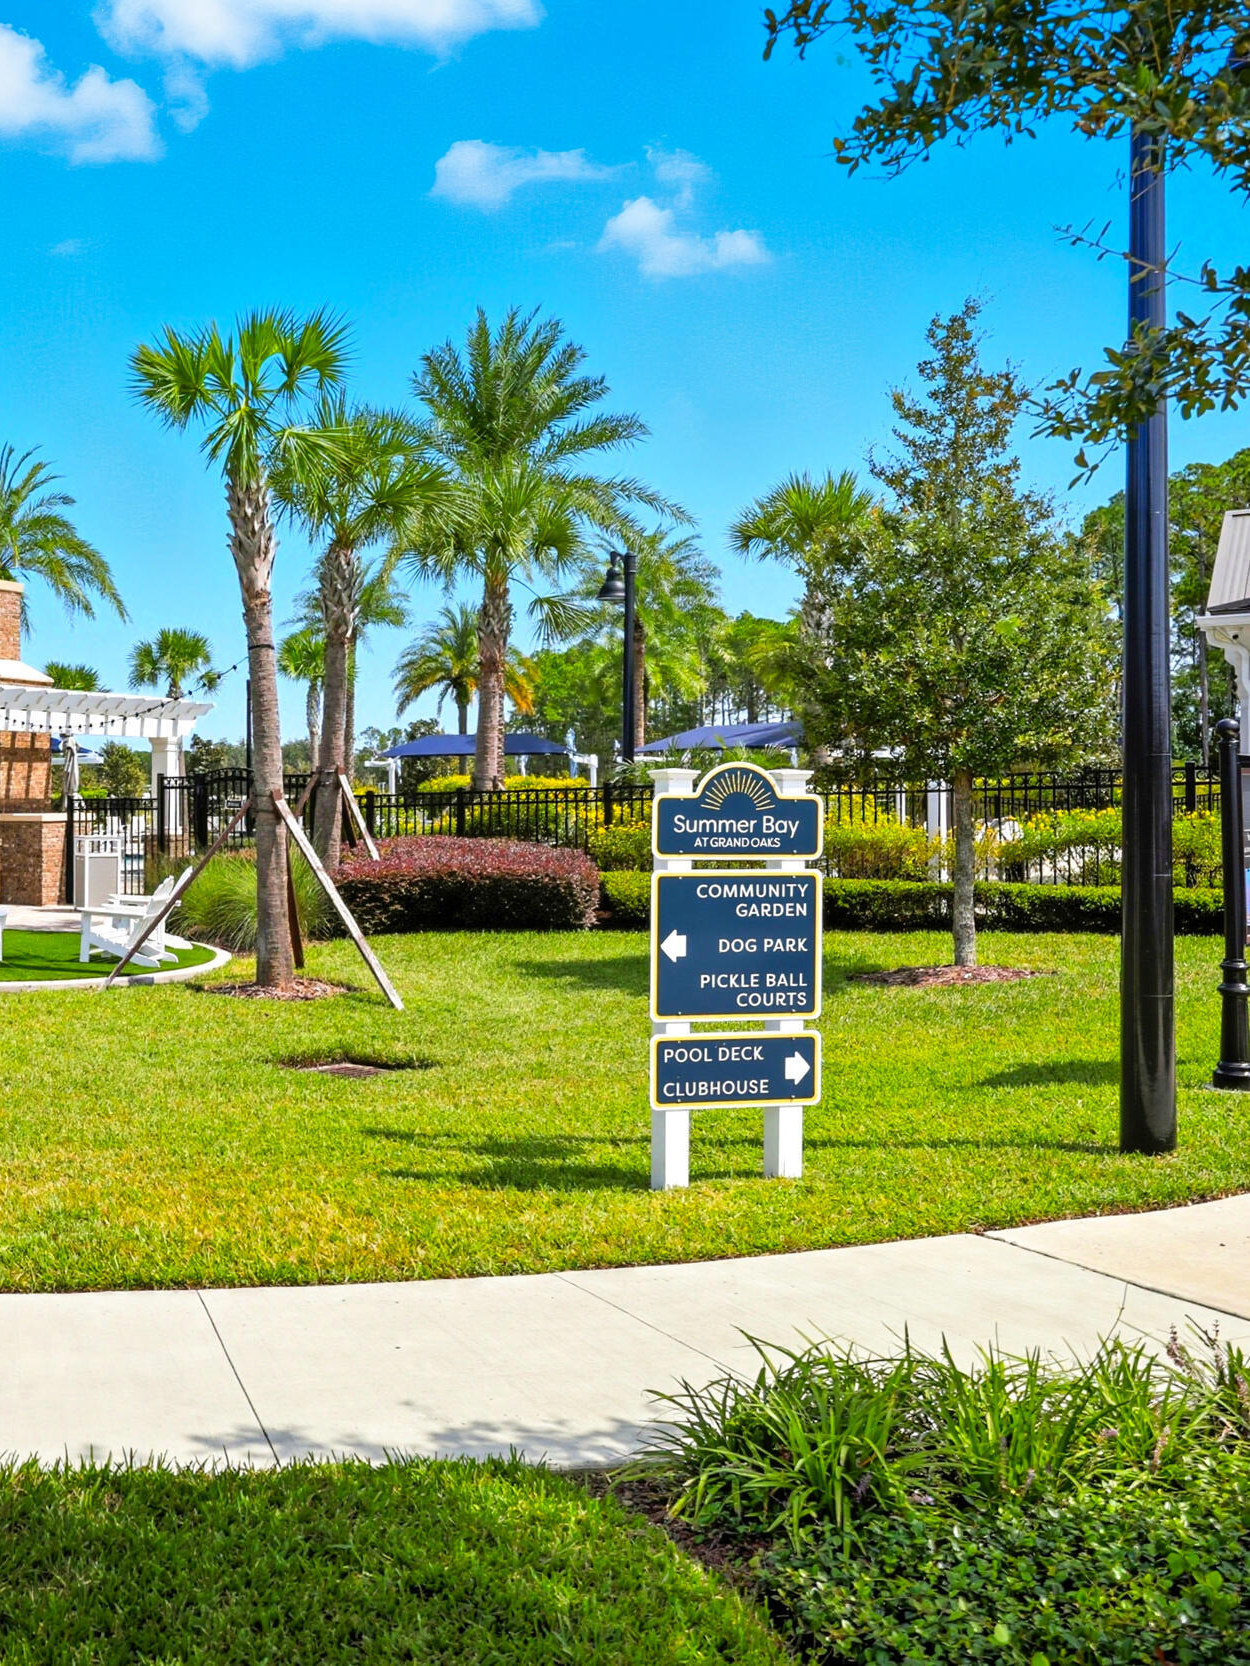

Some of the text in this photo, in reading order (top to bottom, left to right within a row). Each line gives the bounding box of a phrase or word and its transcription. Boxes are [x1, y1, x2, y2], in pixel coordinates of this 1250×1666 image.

[673, 815, 800, 839] Summer Bay
[693, 836, 781, 848] AT GRAND OAKS
[696, 883, 809, 899] COMMUNITY
[735, 902, 807, 918] GARDEN
[718, 937, 808, 953] DOG PARK
[700, 972, 808, 989] PICKLE BALL
[736, 991, 807, 1007] COURTS
[664, 1046, 764, 1063] POOL DECK
[663, 1079, 769, 1097] CLUBHOUSE
